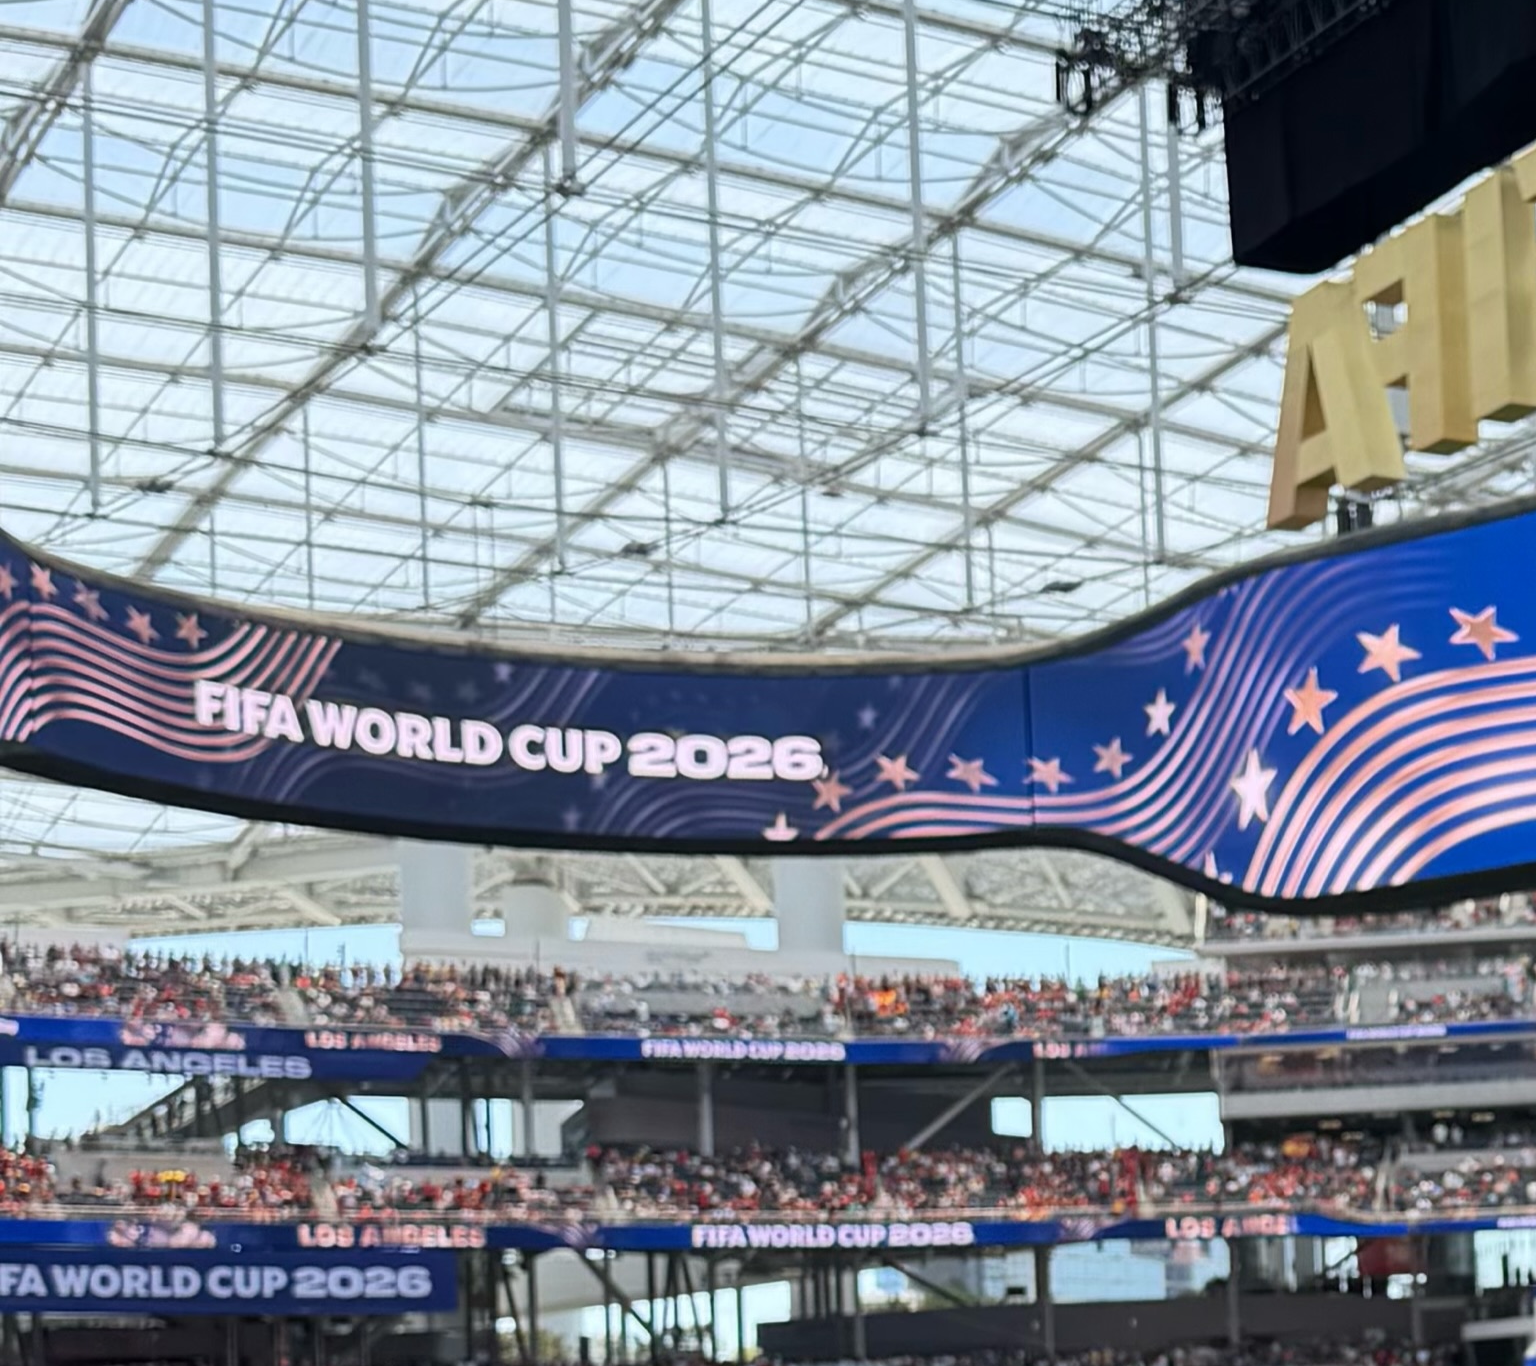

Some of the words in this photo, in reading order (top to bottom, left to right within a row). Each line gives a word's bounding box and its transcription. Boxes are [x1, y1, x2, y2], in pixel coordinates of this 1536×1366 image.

[195, 679, 303, 742] FIFA
[306, 699, 504, 768] WORLD
[509, 725, 623, 775] CUP
[627, 733, 824, 781] 2026
[25, 1046, 111, 1068] LOS
[121, 1050, 312, 1079] ANGELES
[298, 1223, 354, 1248] LOS
[692, 1224, 747, 1248] FIFA
[747, 1223, 836, 1248] WORLD
[837, 1223, 887, 1248] CUP
[888, 1221, 974, 1246] 2026
[52, 1264, 202, 1298] WORLD
[206, 1265, 288, 1298] CUP
[292, 1266, 432, 1299] 2026
